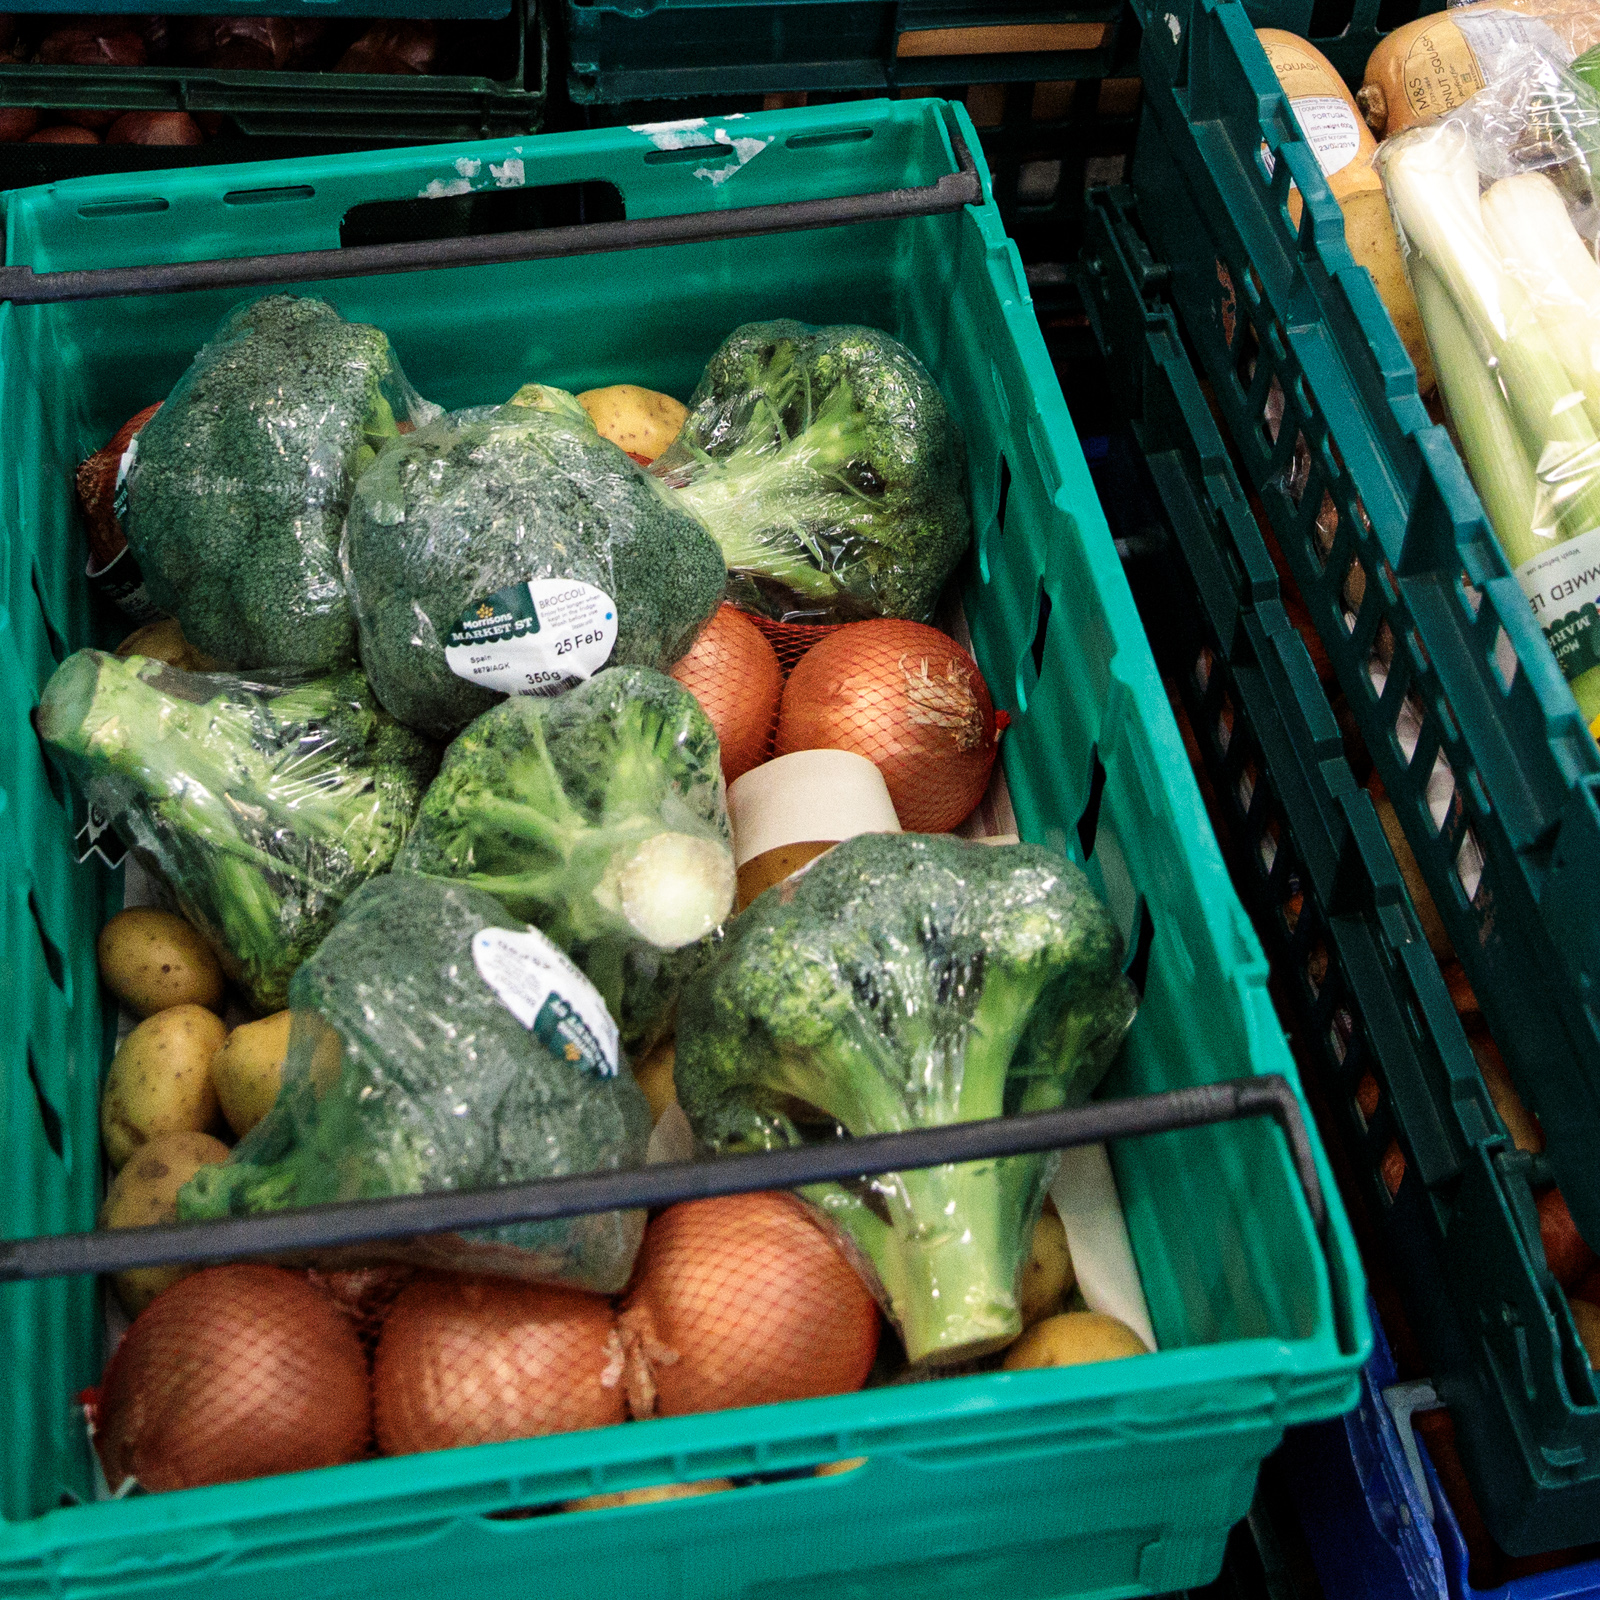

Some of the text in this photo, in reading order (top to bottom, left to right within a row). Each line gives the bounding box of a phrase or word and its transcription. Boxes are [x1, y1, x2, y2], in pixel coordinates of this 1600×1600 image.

[1420, 35, 1445, 75] SQUASH
[1276, 63, 1320, 73] SQUASH
[1409, 77, 1430, 110] M&S
[539, 587, 586, 609] BROCCOLI
[451, 617, 533, 641] MARKET ST
[462, 612, 513, 630] Morrisons
[555, 629, 604, 655] 25 Feb
[470, 654, 493, 665] Spain
[525, 671, 562, 686] 350g
